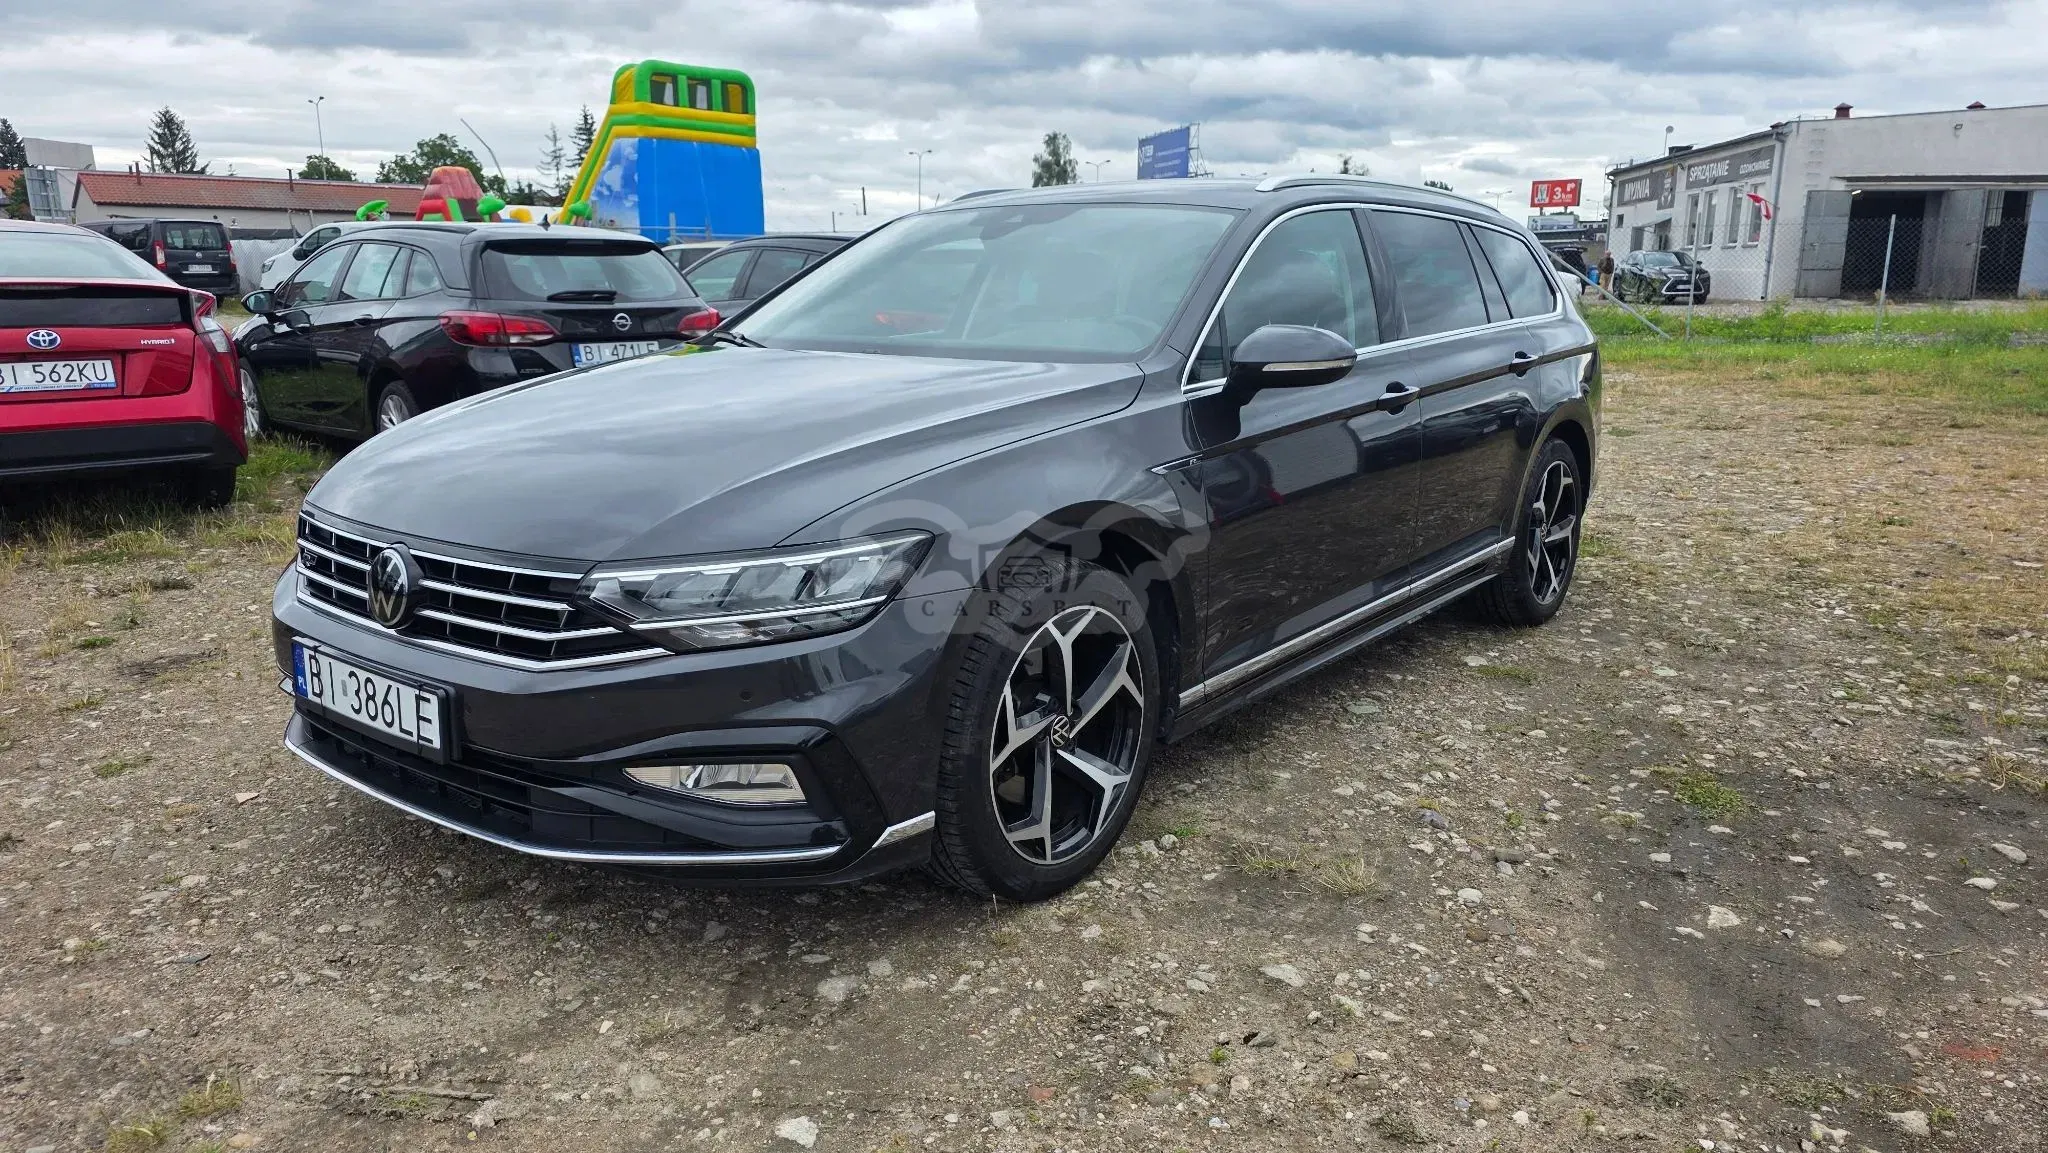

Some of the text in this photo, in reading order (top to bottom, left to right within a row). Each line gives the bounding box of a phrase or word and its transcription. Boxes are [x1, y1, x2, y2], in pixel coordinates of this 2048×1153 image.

[1689, 160, 1730, 182] SPRZĄTANIE
[583, 344, 602, 361] BI
[31, 362, 108, 383] 562KU
[297, 675, 307, 690] PL
[308, 654, 434, 745] BI 386LE
